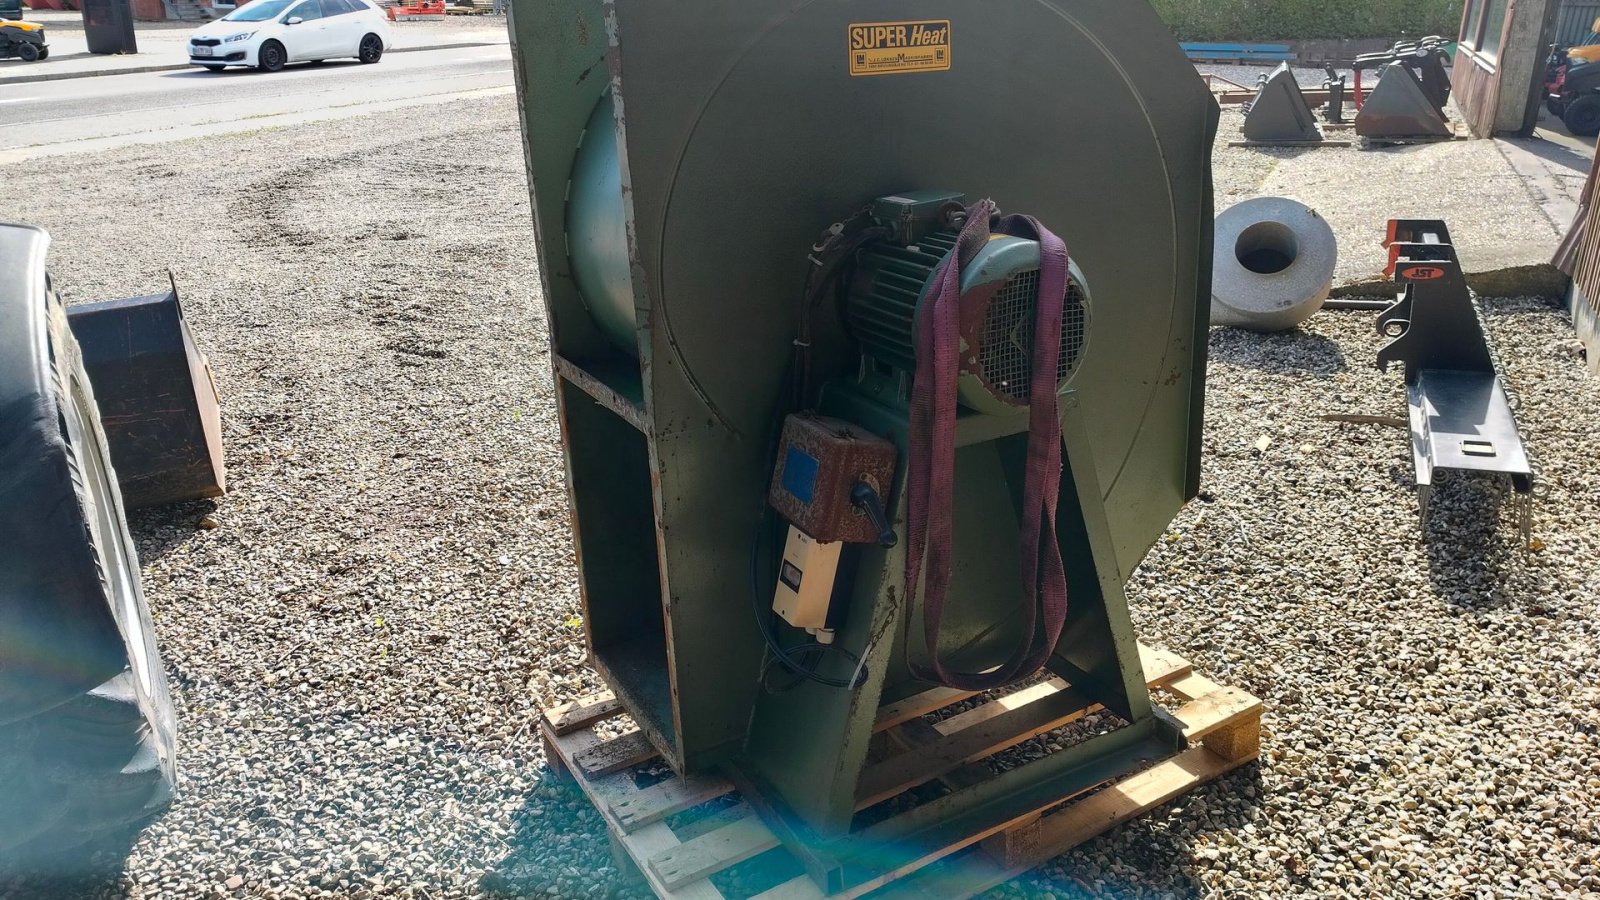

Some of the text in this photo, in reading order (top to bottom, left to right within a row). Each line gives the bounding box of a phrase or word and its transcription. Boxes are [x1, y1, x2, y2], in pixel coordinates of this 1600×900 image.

[852, 25, 947, 49] SUPER Heat
[1411, 269, 1435, 277] JST
